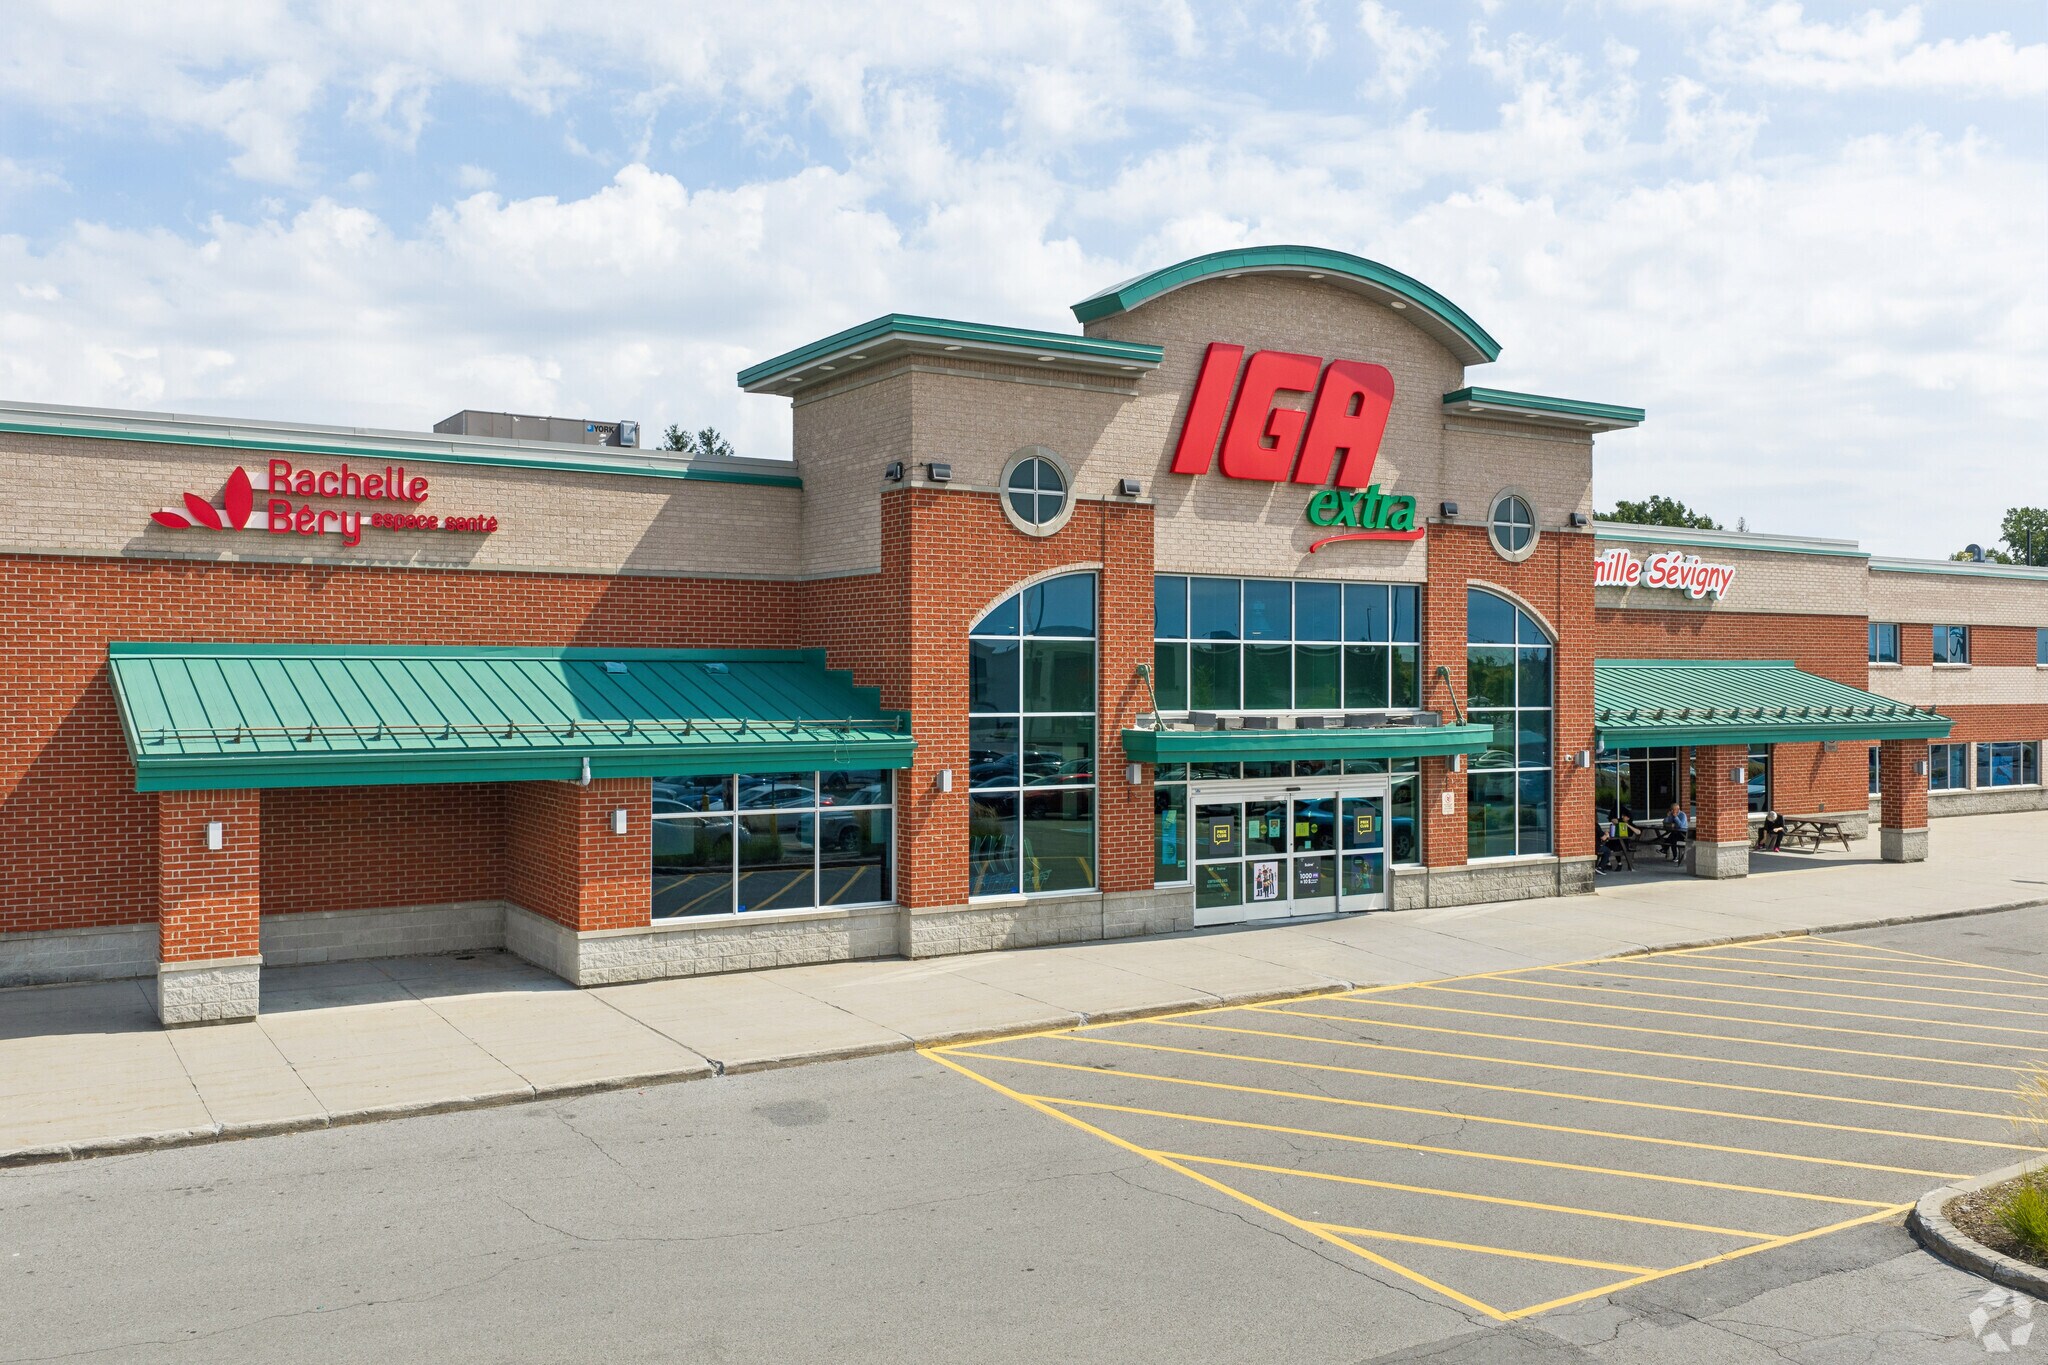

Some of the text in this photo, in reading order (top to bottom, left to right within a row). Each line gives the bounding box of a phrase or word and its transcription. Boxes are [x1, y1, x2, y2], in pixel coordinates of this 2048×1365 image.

[594, 424, 615, 433] YORK
[1169, 342, 1395, 488] IGA
[268, 458, 429, 503] Rachelle
[268, 498, 361, 547] Béry
[371, 512, 498, 533] espace santé
[1306, 483, 1417, 531] extra
[1649, 555, 1734, 597] Sévigny
